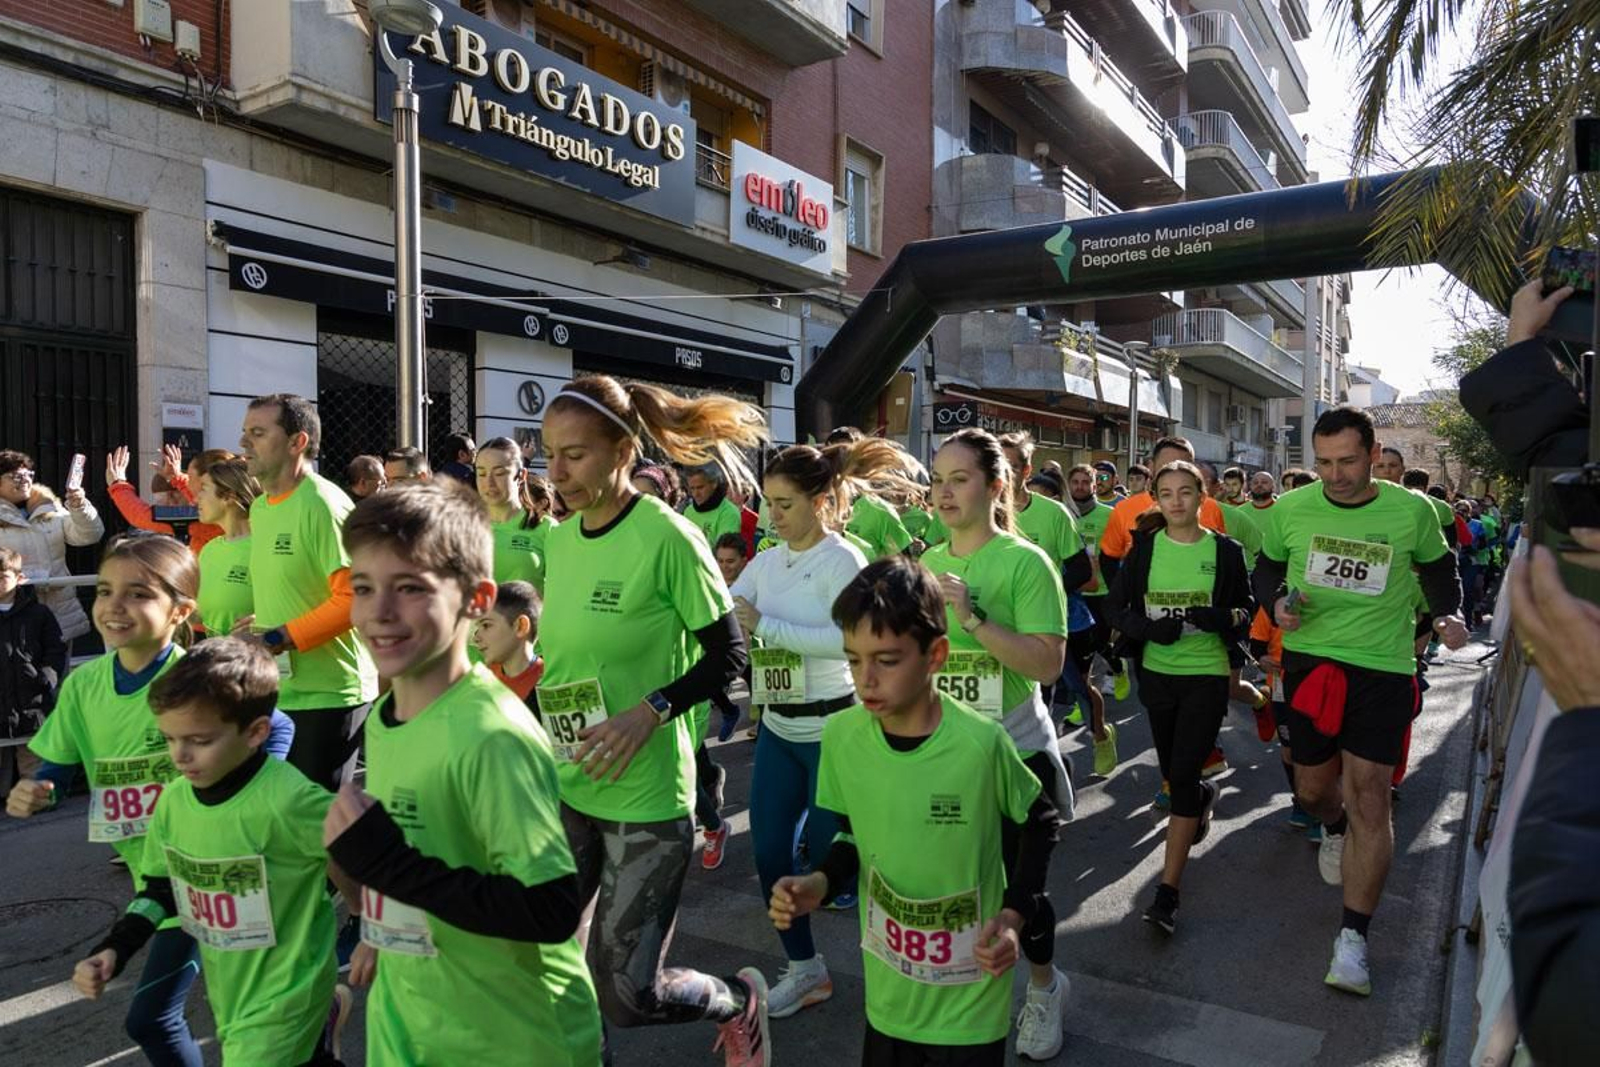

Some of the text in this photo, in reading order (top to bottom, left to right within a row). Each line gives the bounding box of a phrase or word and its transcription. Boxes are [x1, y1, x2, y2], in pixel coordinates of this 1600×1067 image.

[407, 24, 685, 161] ABOGADOS
[746, 206, 827, 254] diseño gráfico
[1081, 216, 1255, 251] Patronato Municipal de
[1081, 239, 1213, 268] Deportes de Jaén
[675, 346, 702, 368] PASOS
[1324, 556, 1369, 581] 266
[764, 668, 792, 690] 800
[103, 783, 164, 822] 987
[885, 918, 952, 966] 983
